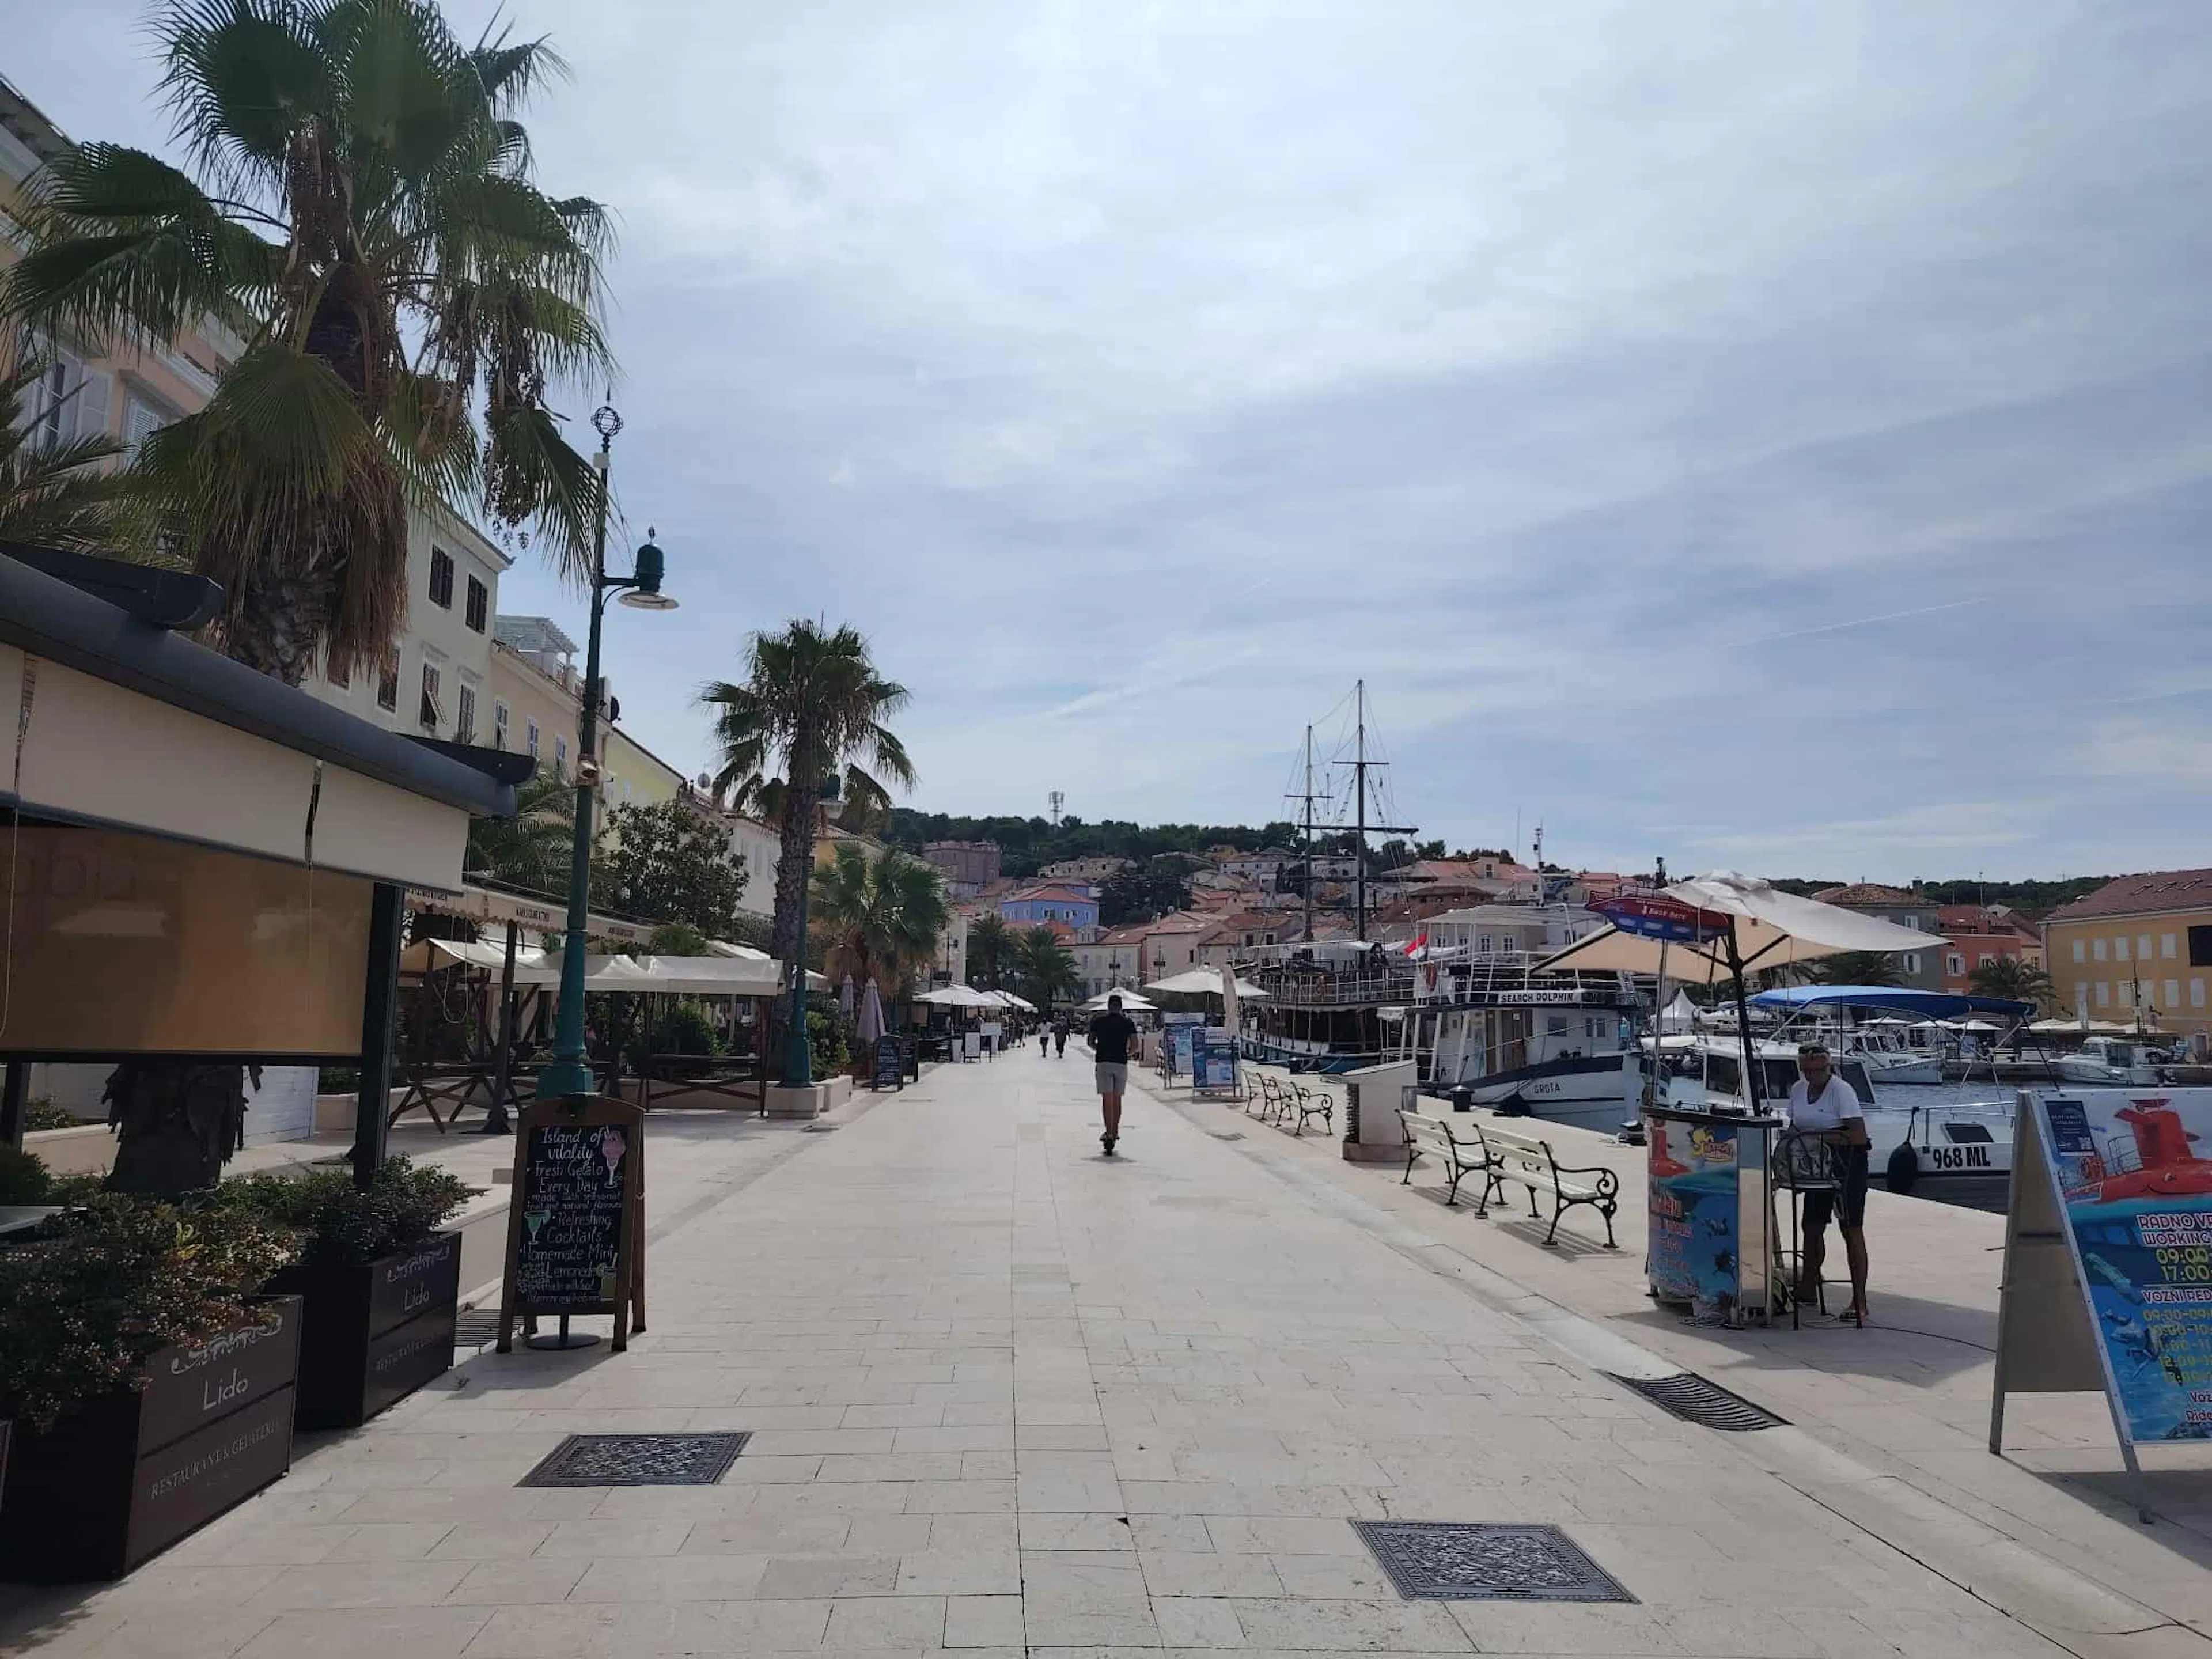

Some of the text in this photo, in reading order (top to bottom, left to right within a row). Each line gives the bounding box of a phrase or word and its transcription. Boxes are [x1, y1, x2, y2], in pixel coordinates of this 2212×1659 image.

[1501, 992, 1573, 1003] SEARCH DOLPHIN
[1534, 1082, 1560, 1094] GROTA
[540, 1127, 605, 1147] Island of
[1933, 1146, 1991, 1169] 968 ML
[535, 1159, 604, 1177] Fresh Gelato
[539, 1176, 598, 1194] Every Day
[556, 1210, 612, 1231] Refreshing
[2137, 1213, 2195, 1229] RADNO
[548, 1226, 603, 1244] Cocktails
[2142, 1231, 2211, 1247] WORKING
[404, 1280, 431, 1312] Lido
[2142, 1289, 2186, 1304] VOZNI
[203, 1367, 249, 1410] Lido
